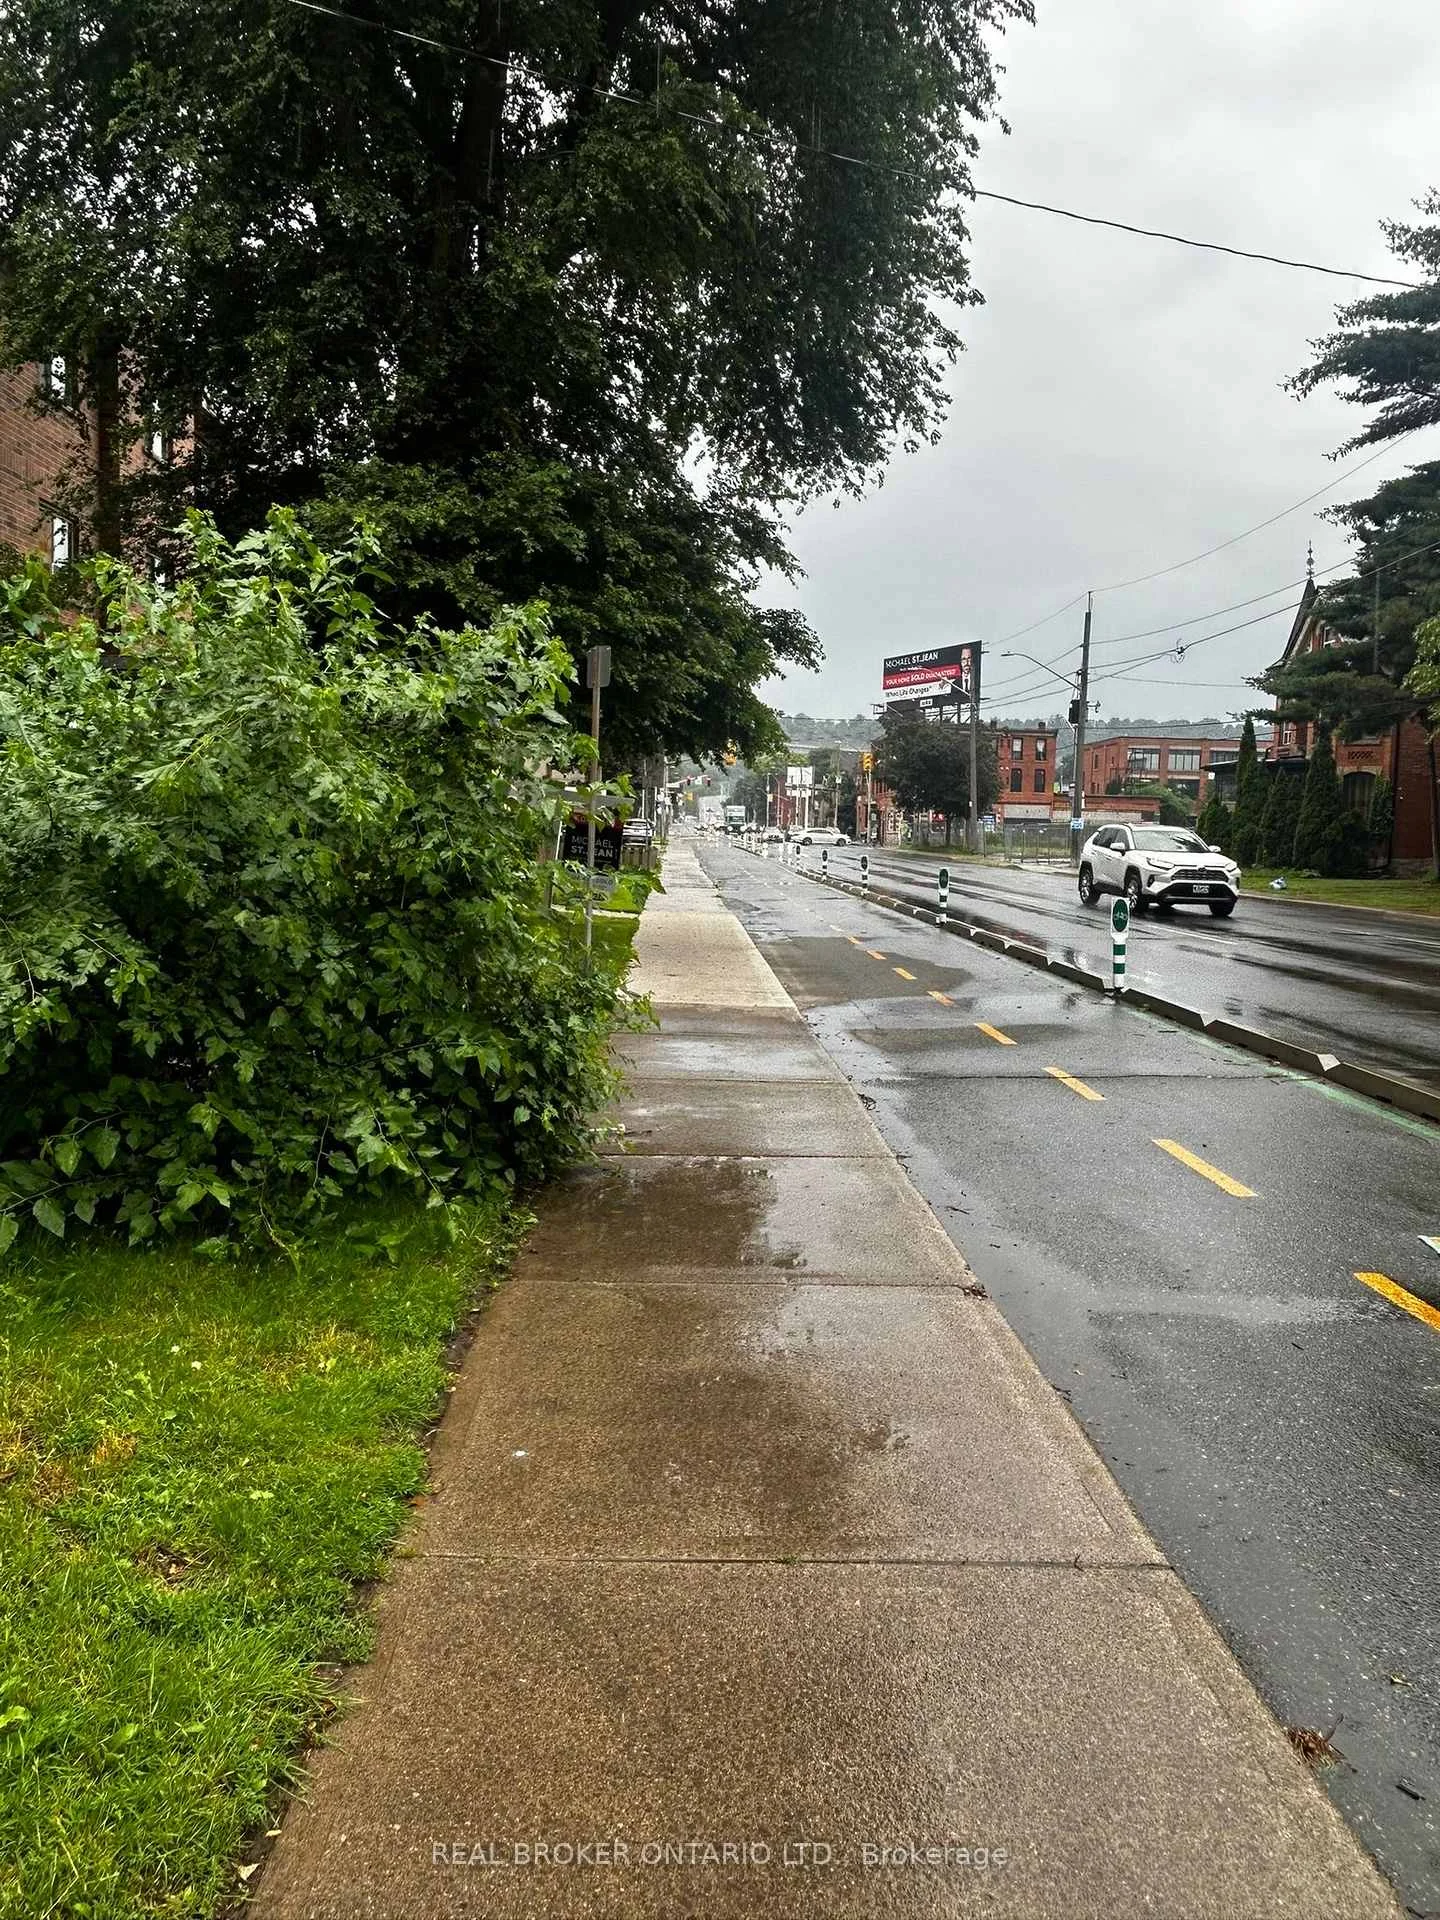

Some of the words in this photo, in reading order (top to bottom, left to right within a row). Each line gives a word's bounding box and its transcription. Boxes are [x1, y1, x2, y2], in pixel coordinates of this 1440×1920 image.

[885, 658, 911, 668] MICHAEL
[911, 672, 925, 682] SOLD
[571, 836, 613, 848] MICAEL
[571, 846, 613, 857] ST.EAN
